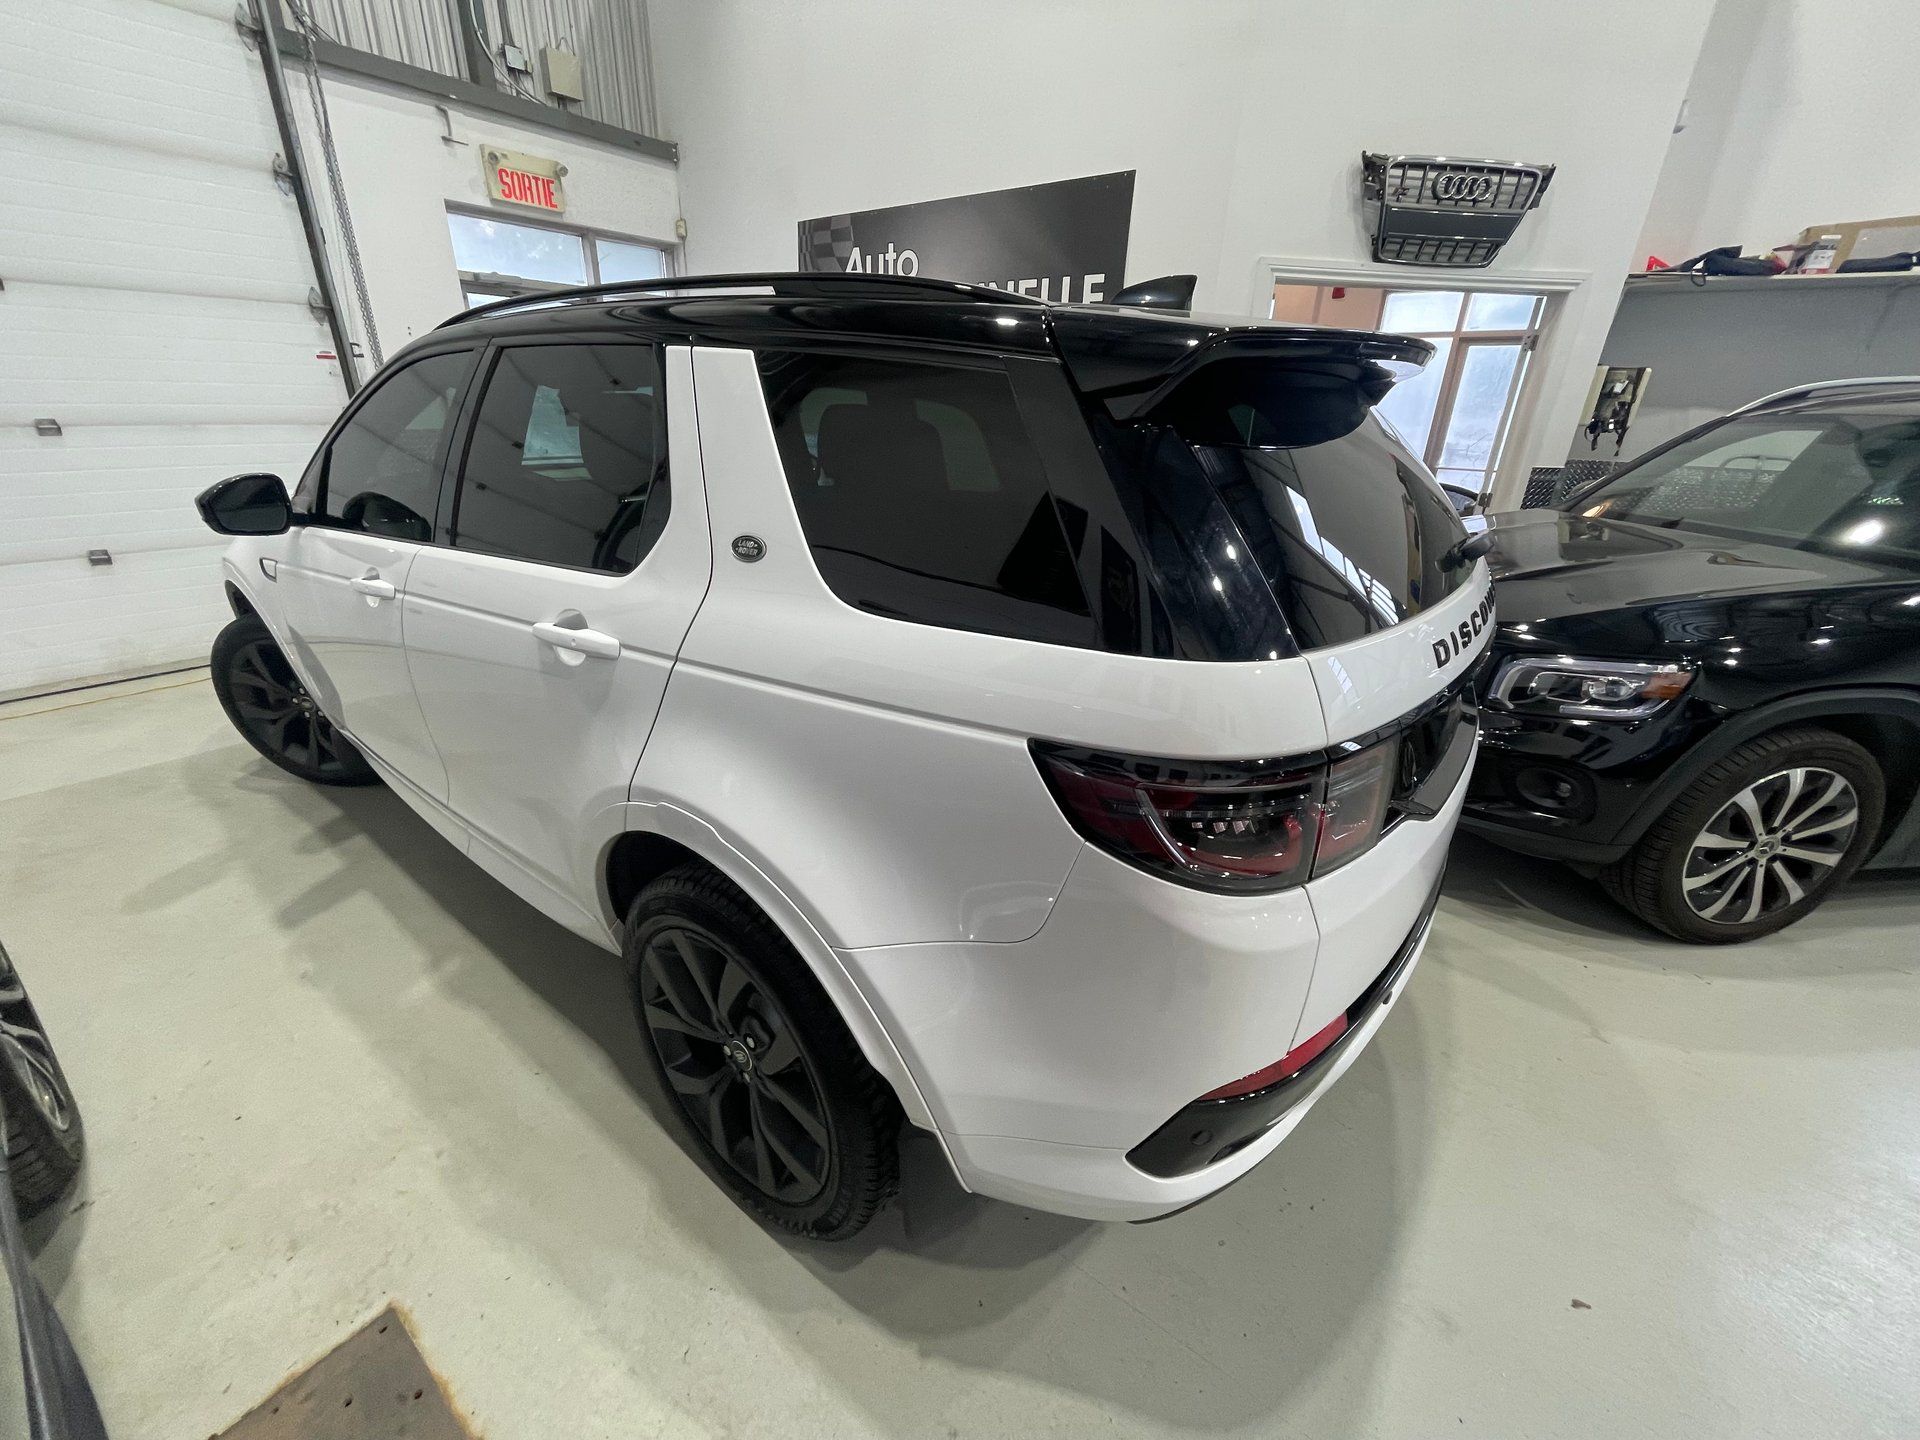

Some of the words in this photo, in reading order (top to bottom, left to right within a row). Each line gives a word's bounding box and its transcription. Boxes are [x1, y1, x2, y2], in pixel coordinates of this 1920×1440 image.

[498, 168, 558, 208] SORTIE
[845, 242, 919, 277] Auto
[1432, 582, 1495, 669] DISCOV
